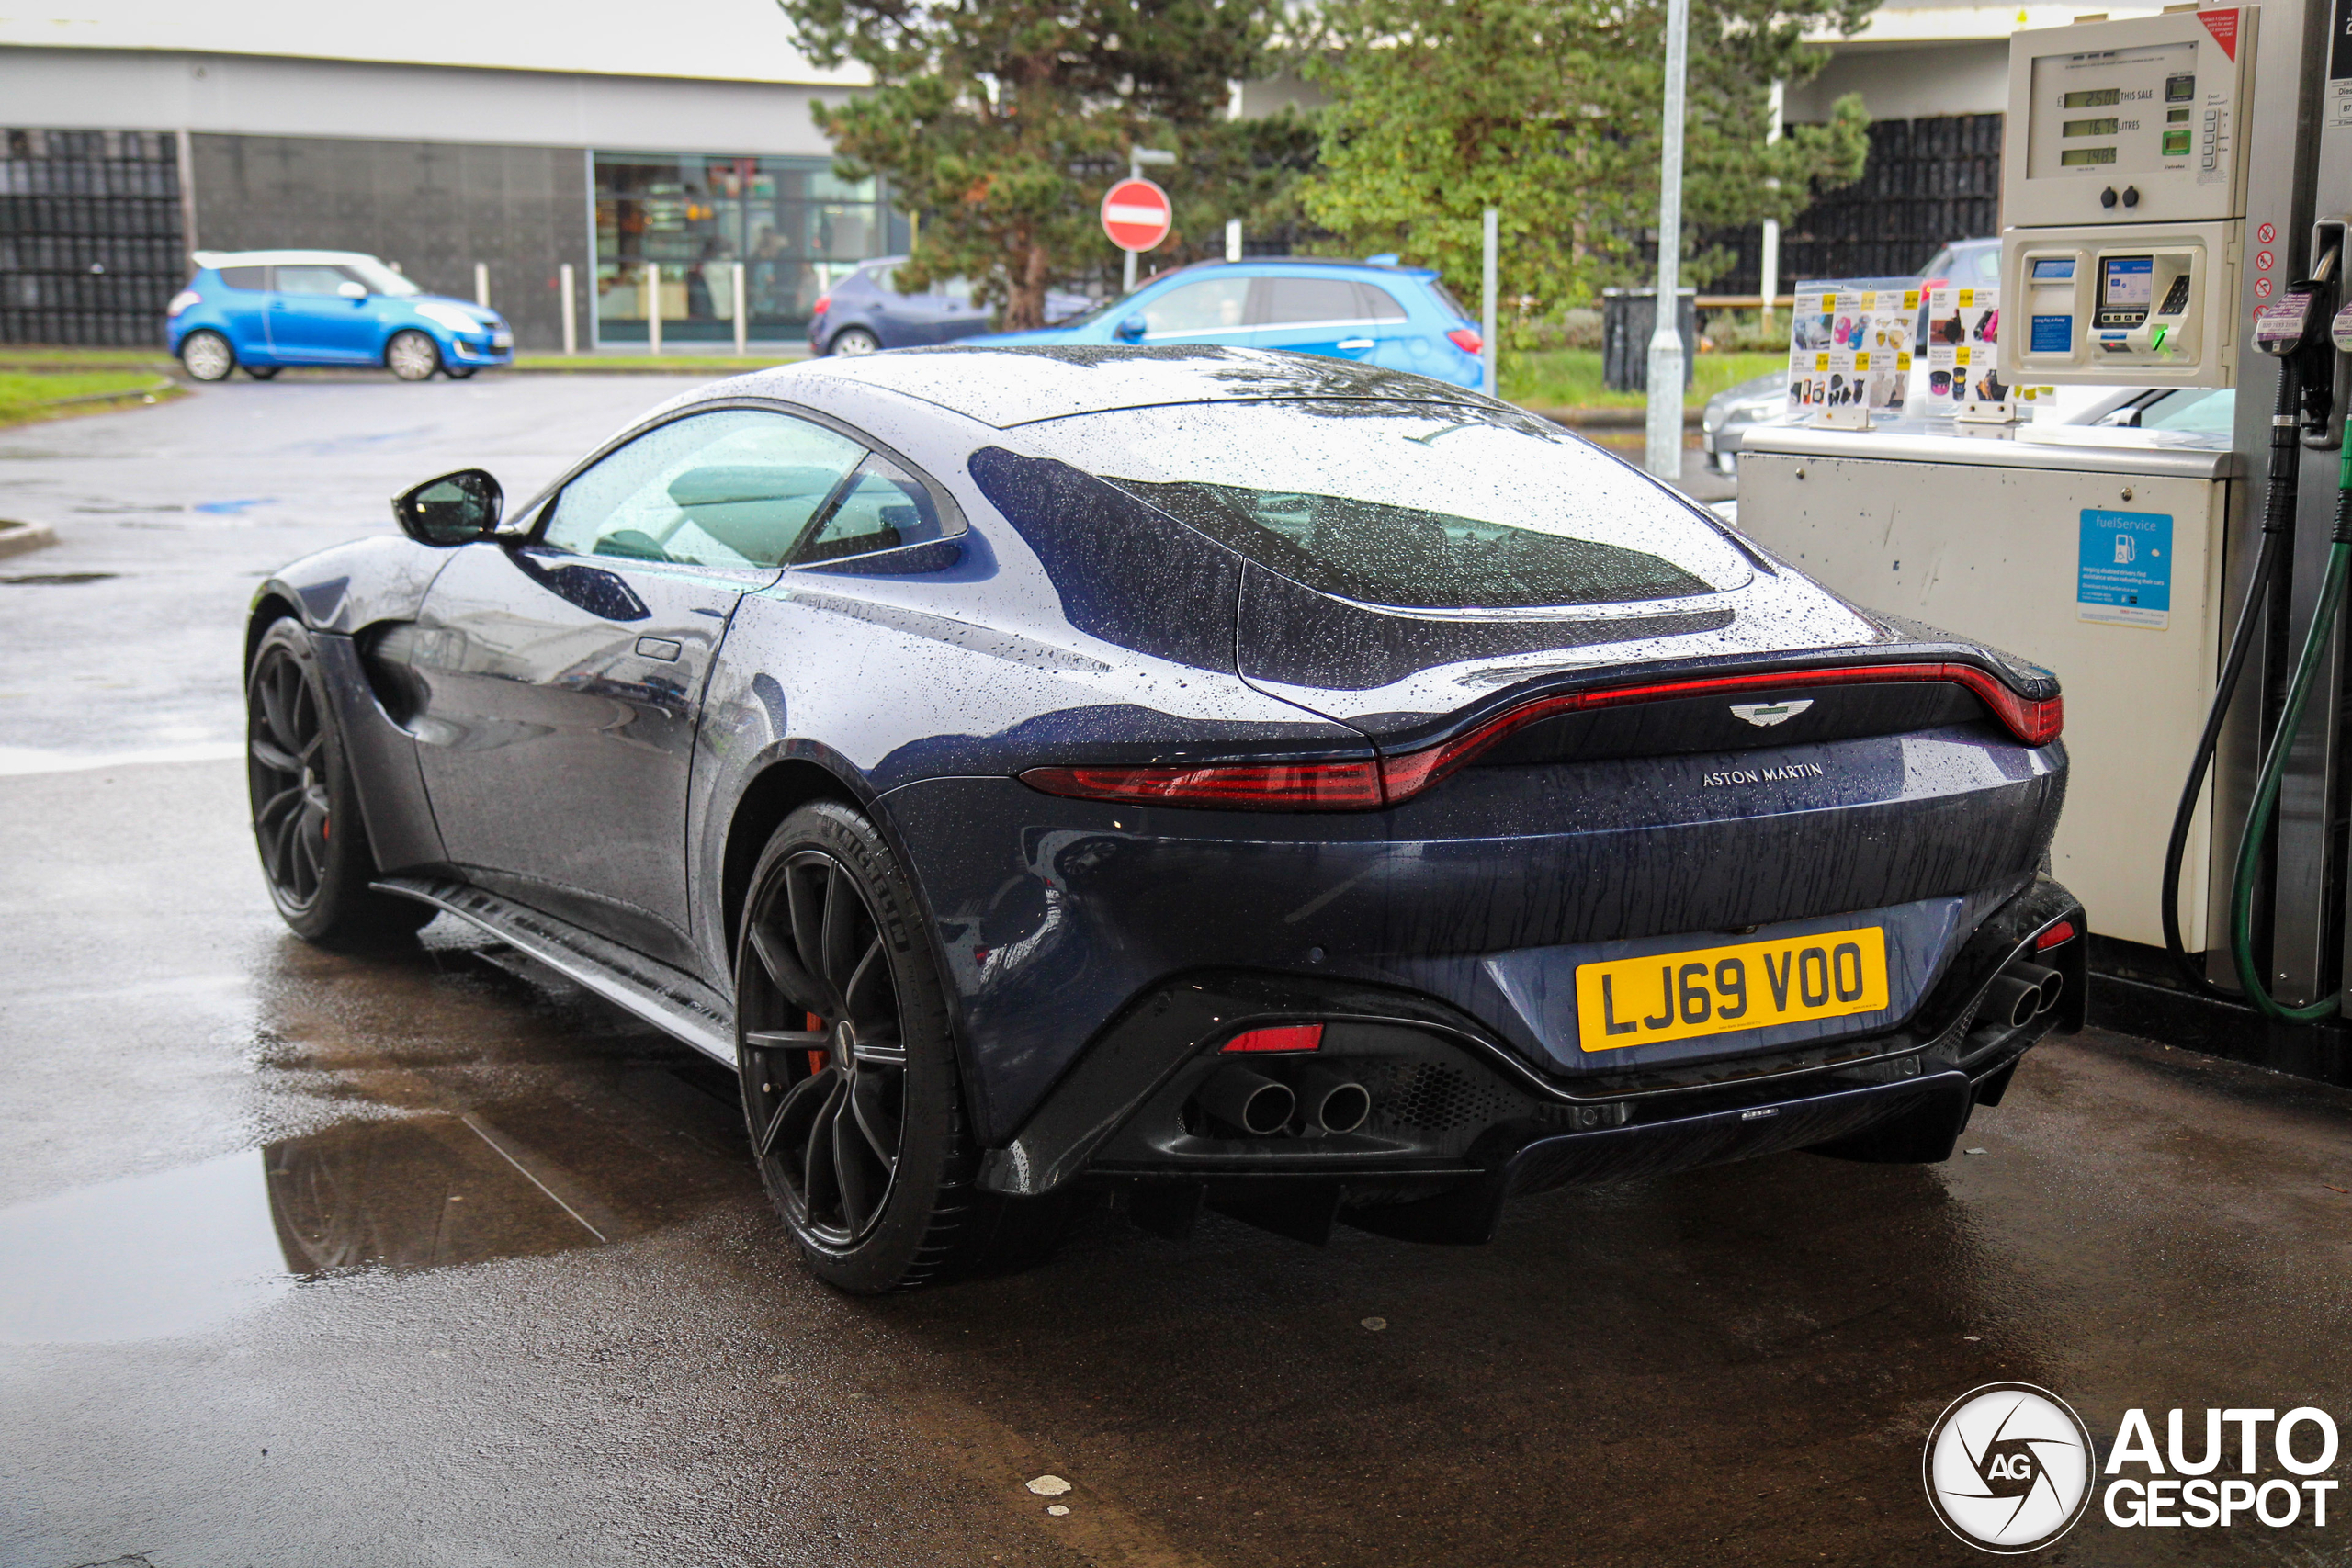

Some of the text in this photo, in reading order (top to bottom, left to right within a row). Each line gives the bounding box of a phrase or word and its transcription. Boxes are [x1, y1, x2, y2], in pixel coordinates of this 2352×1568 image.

[2120, 89, 2153, 101] THIS SALE
[2119, 120, 2140, 130] LITRES
[2096, 516, 2156, 531] fuelService
[2083, 566, 2100, 574] Helping
[2100, 567, 2120, 575] disabled
[2120, 569, 2136, 577] drivers
[2120, 576, 2142, 585] refuelling
[1703, 762, 1824, 787] ASTON MARTIN
[840, 829, 908, 944] MICHELIN
[1602, 942, 1863, 1036] LJ69 VOO
